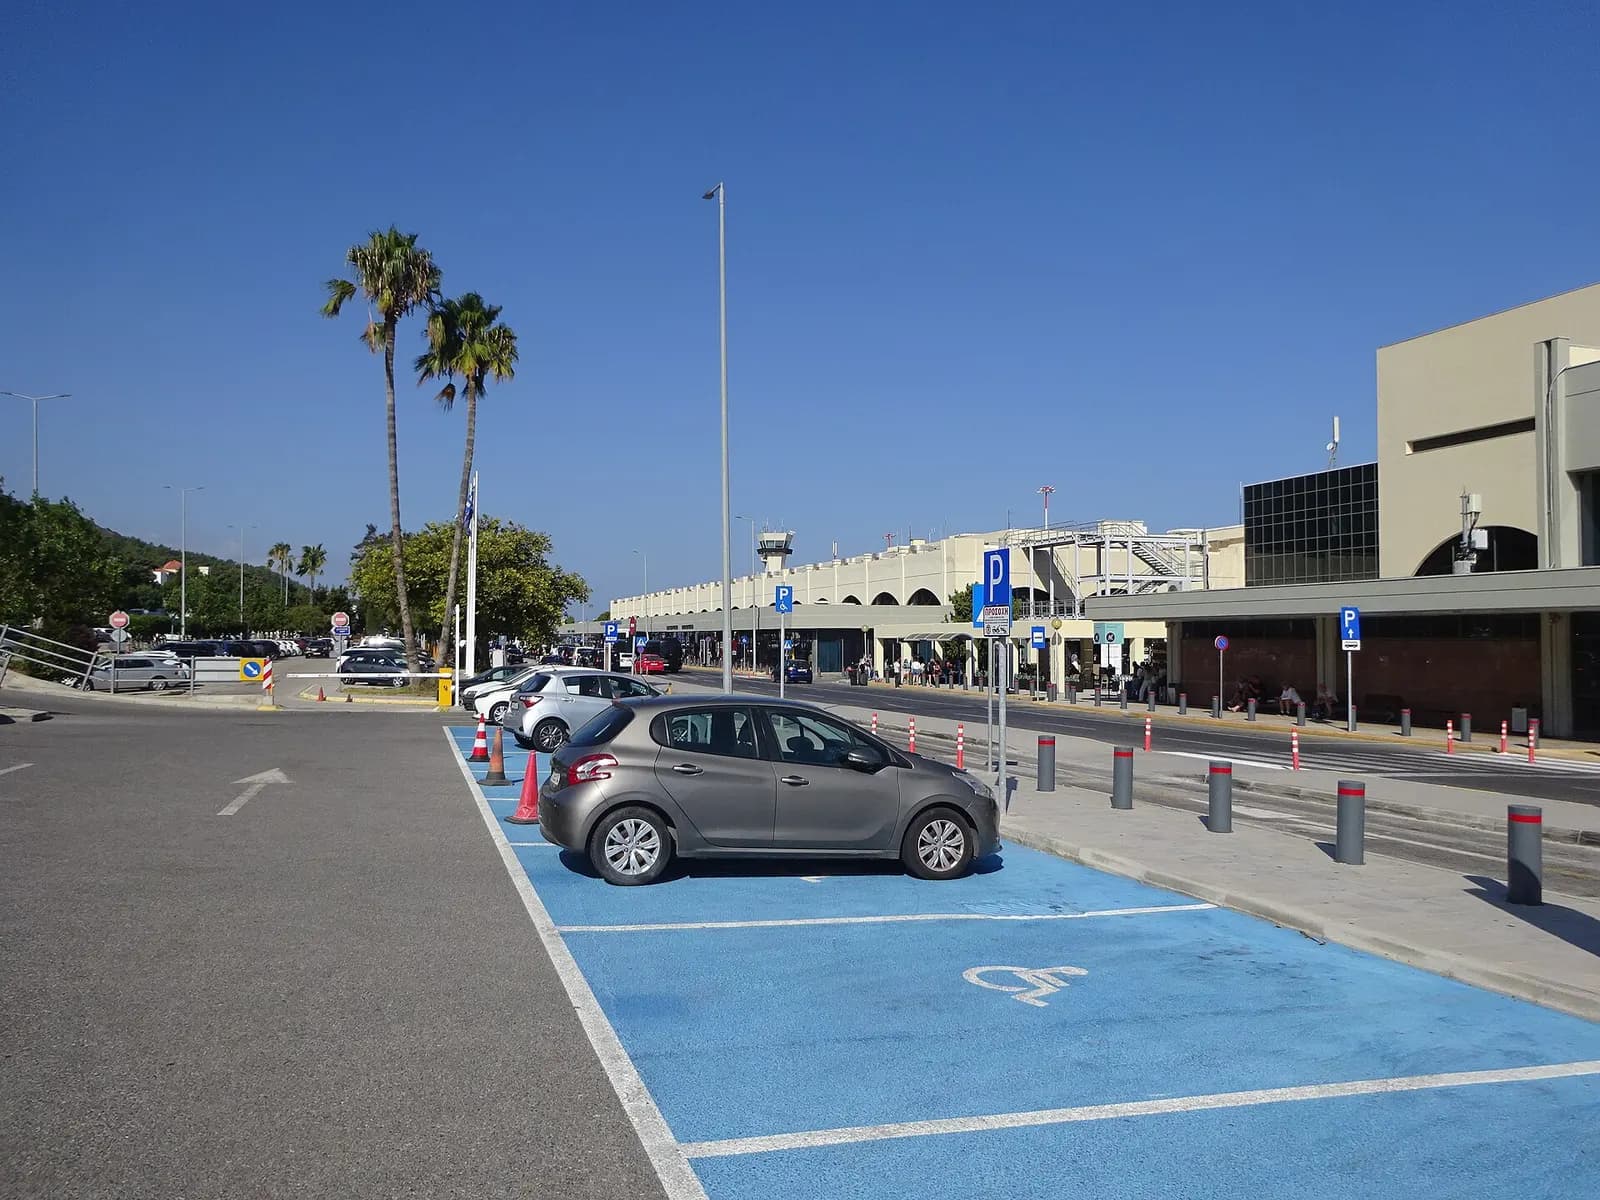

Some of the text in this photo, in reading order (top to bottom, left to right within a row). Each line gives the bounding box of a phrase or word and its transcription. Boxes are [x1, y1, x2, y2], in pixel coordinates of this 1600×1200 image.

[989, 554, 1003, 602] P
[780, 588, 789, 601] P
[1344, 610, 1356, 628] P
[607, 624, 616, 636] P
